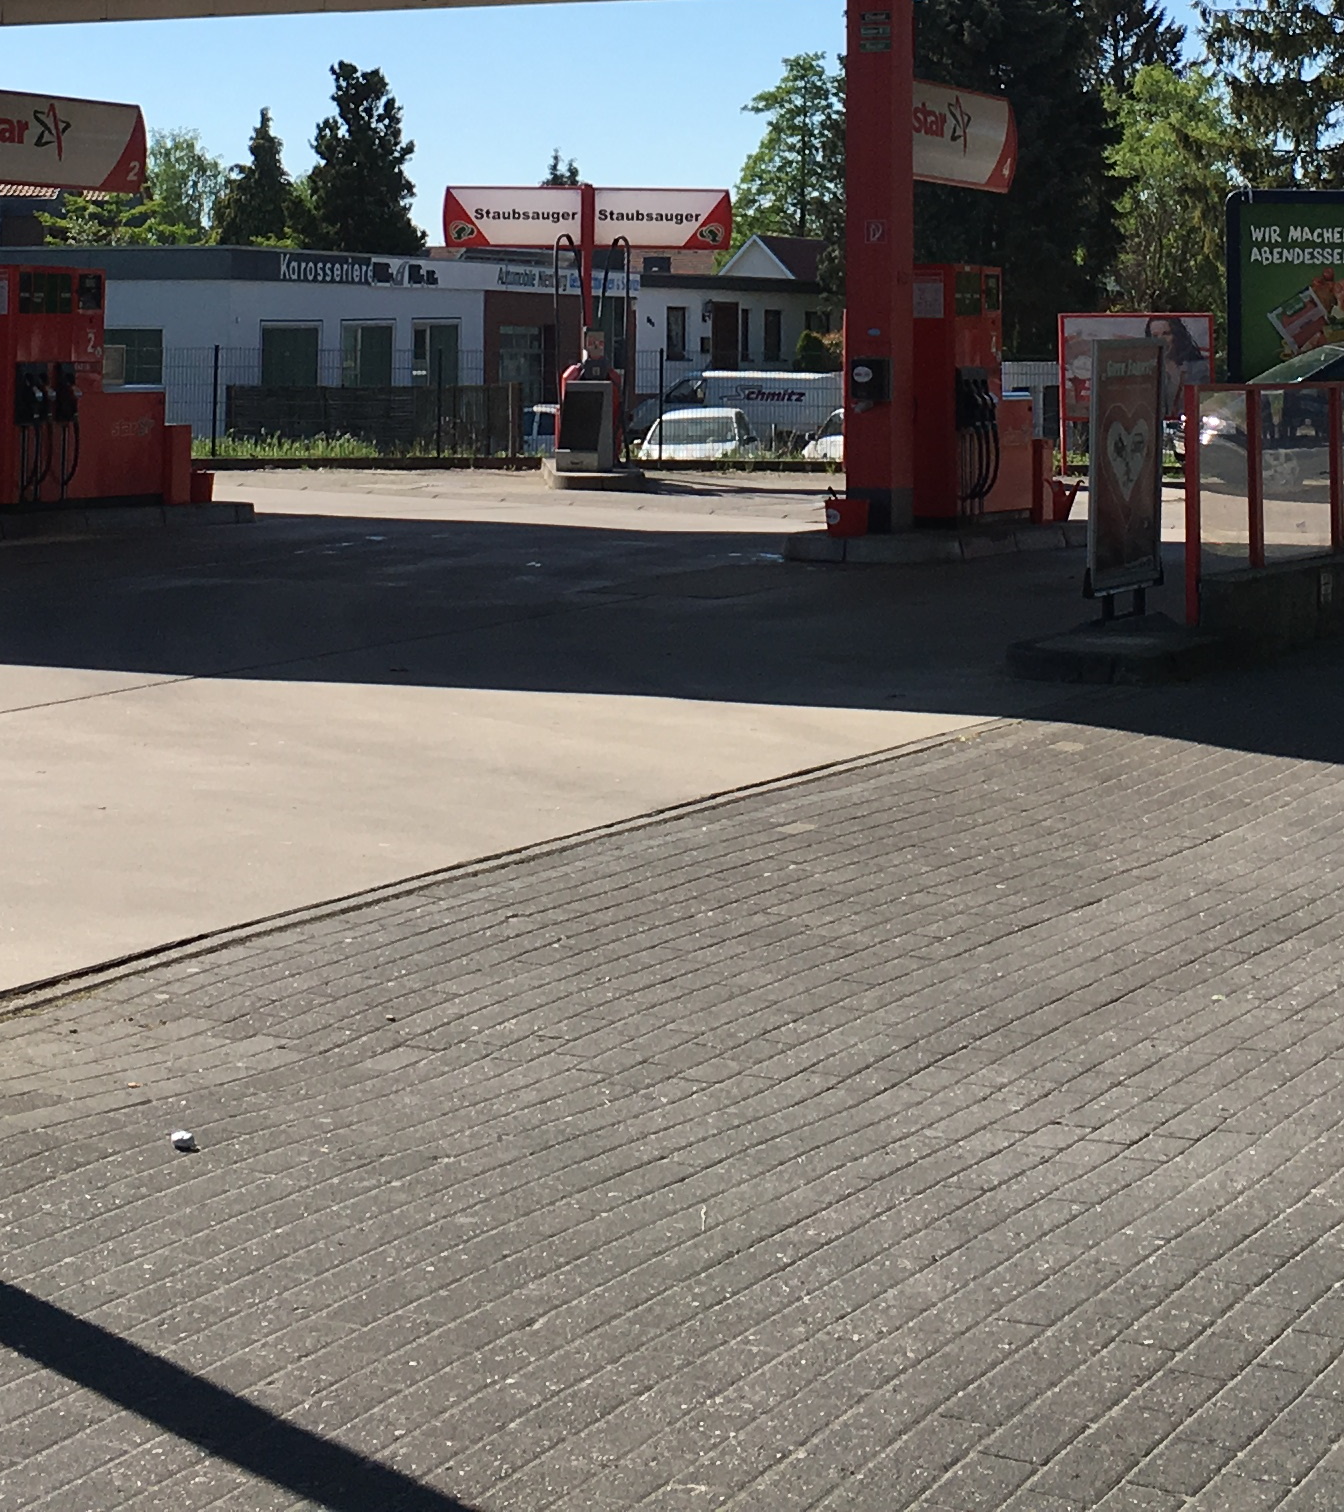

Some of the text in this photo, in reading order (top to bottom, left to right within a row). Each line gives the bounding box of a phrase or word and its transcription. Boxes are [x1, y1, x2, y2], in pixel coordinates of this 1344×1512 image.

[912, 101, 947, 139] star
[127, 161, 140, 182] 2
[1001, 157, 1011, 178] 4
[474, 206, 578, 224] Staubsauger
[597, 207, 702, 226] Staubsauger
[1250, 225, 1281, 243] WIR
[86, 332, 95, 354] 2
[719, 384, 806, 403] Schmitz
